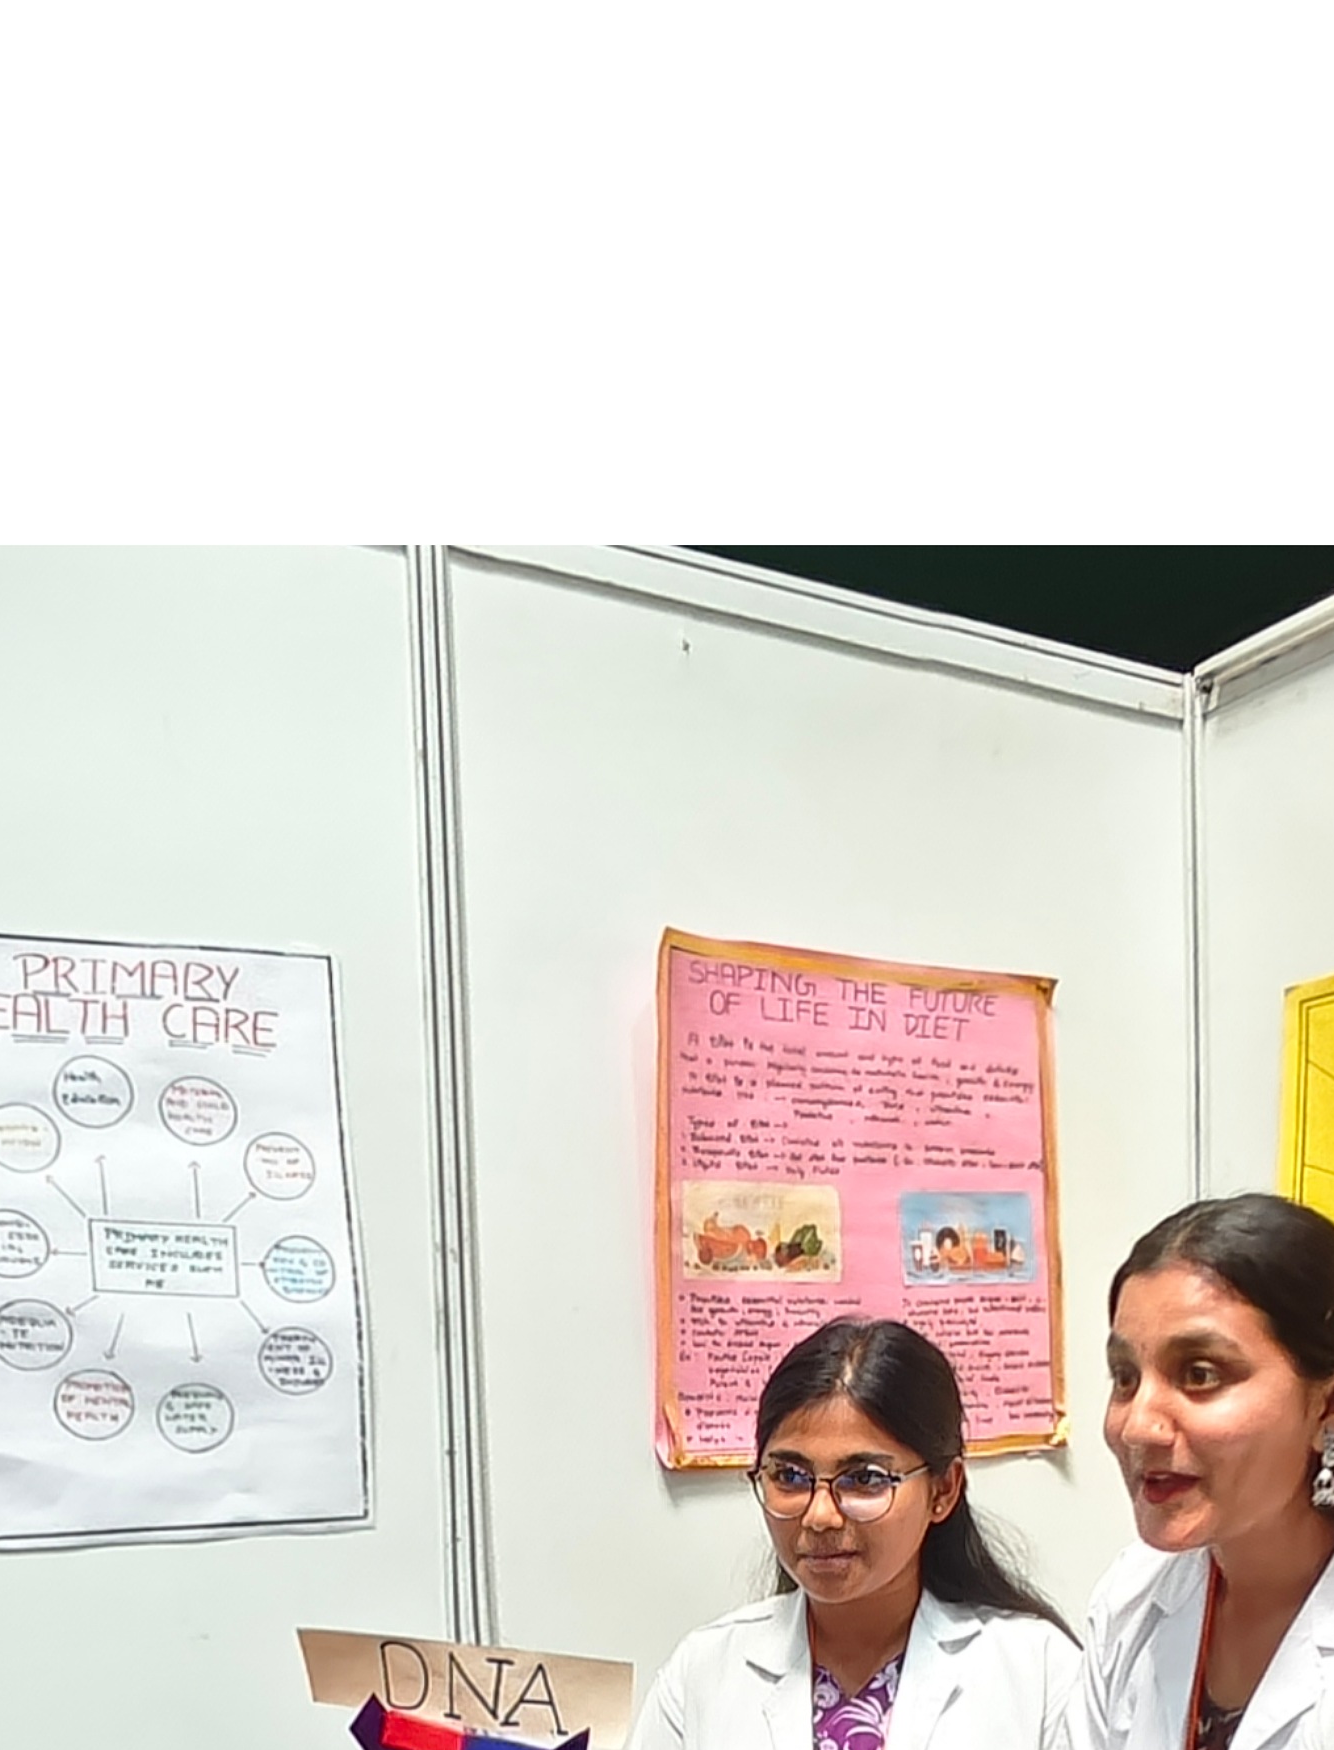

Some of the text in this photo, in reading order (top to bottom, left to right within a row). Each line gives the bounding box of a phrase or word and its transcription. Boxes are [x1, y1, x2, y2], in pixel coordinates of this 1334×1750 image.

[13, 953, 239, 1001] PRIMARY
[688, 960, 999, 1017] SHAPING THE FUTURE
[162, 1003, 279, 1048] CARE
[709, 989, 970, 1041] OF LIFE IN DIET
[380, 1640, 569, 1736] DNA
